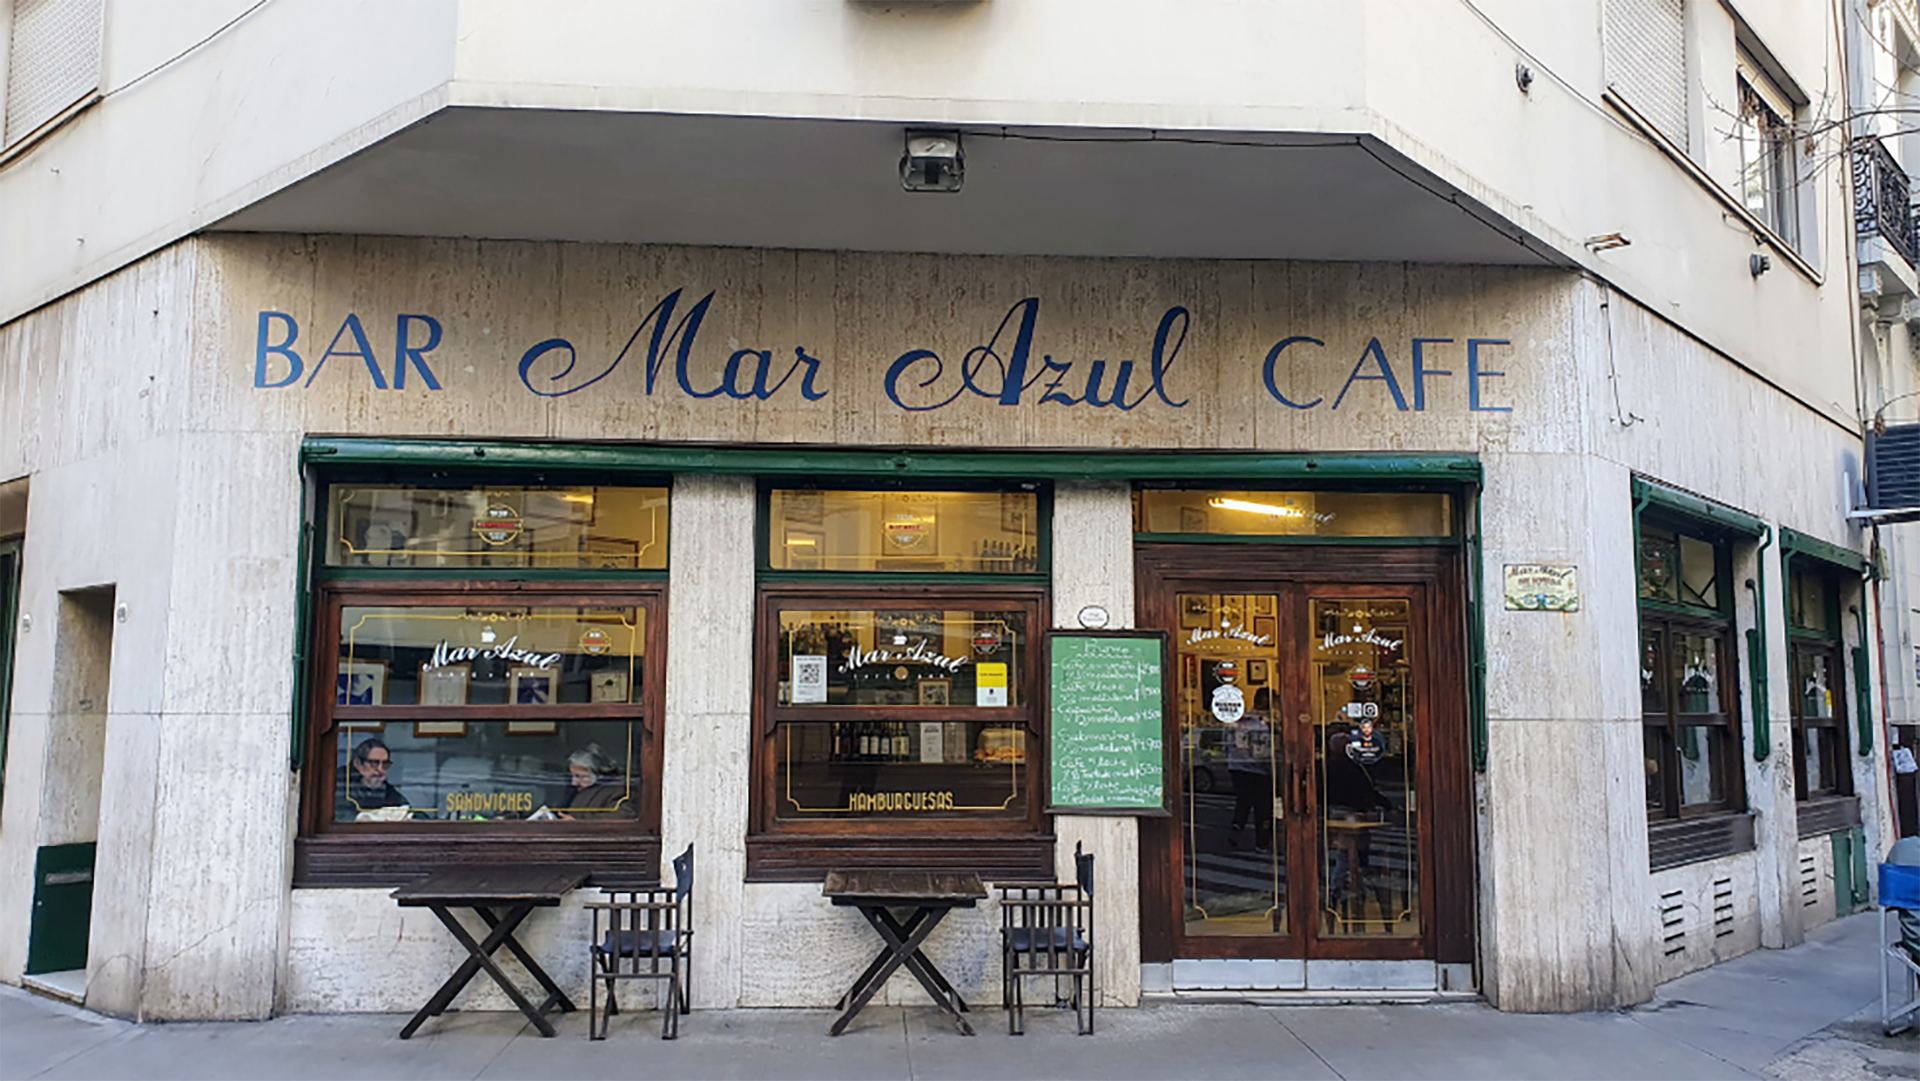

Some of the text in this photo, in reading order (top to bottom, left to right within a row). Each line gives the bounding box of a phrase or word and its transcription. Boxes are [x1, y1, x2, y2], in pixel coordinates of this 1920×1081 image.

[254, 287, 1513, 412] BAR Mar Azul CAFE
[1186, 623, 1270, 647] Mar Azul
[1318, 627, 1403, 651] Mar Azul
[422, 635, 560, 672] Mar Azul
[837, 638, 969, 673] Mar Azul
[446, 792, 533, 812] SANDWICHES
[849, 791, 953, 812] HAMBURGUESAS
